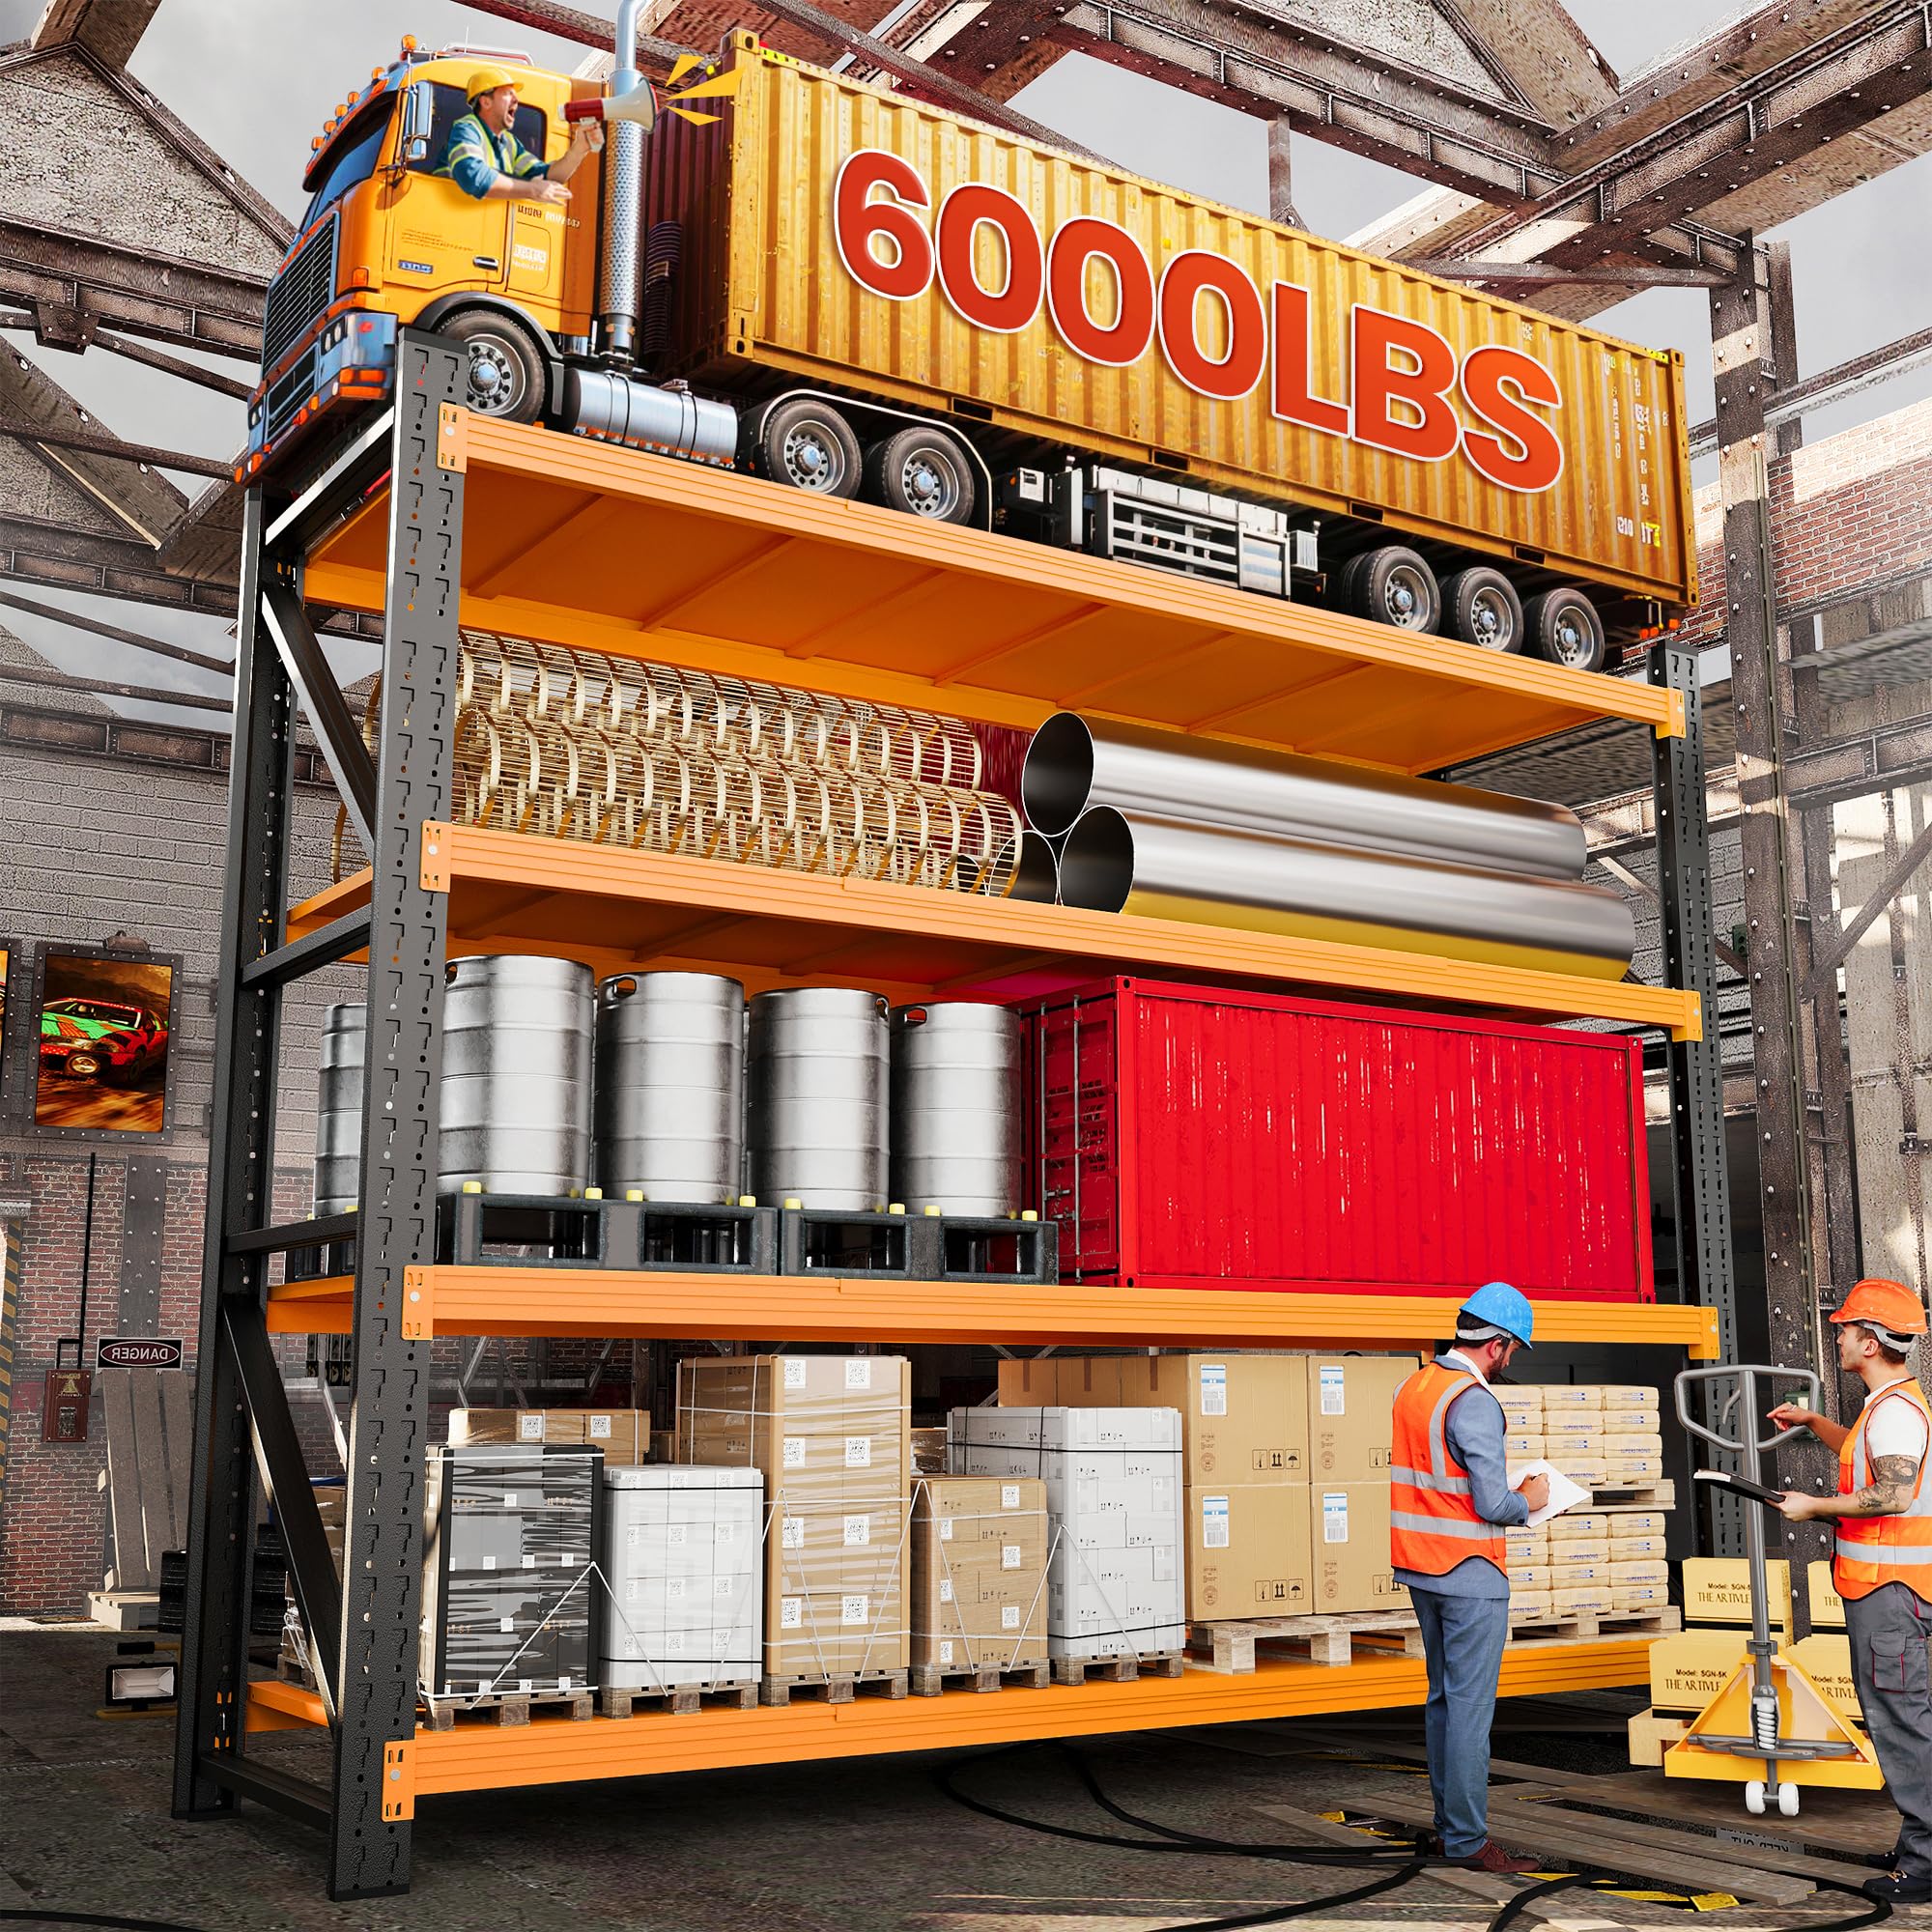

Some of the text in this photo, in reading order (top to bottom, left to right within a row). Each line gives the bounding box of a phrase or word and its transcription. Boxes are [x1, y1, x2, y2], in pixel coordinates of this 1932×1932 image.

[834, 148, 1565, 494] 6000LBS
[1698, 1592, 1715, 1603] THE
[1664, 1679, 1682, 1690] THE
